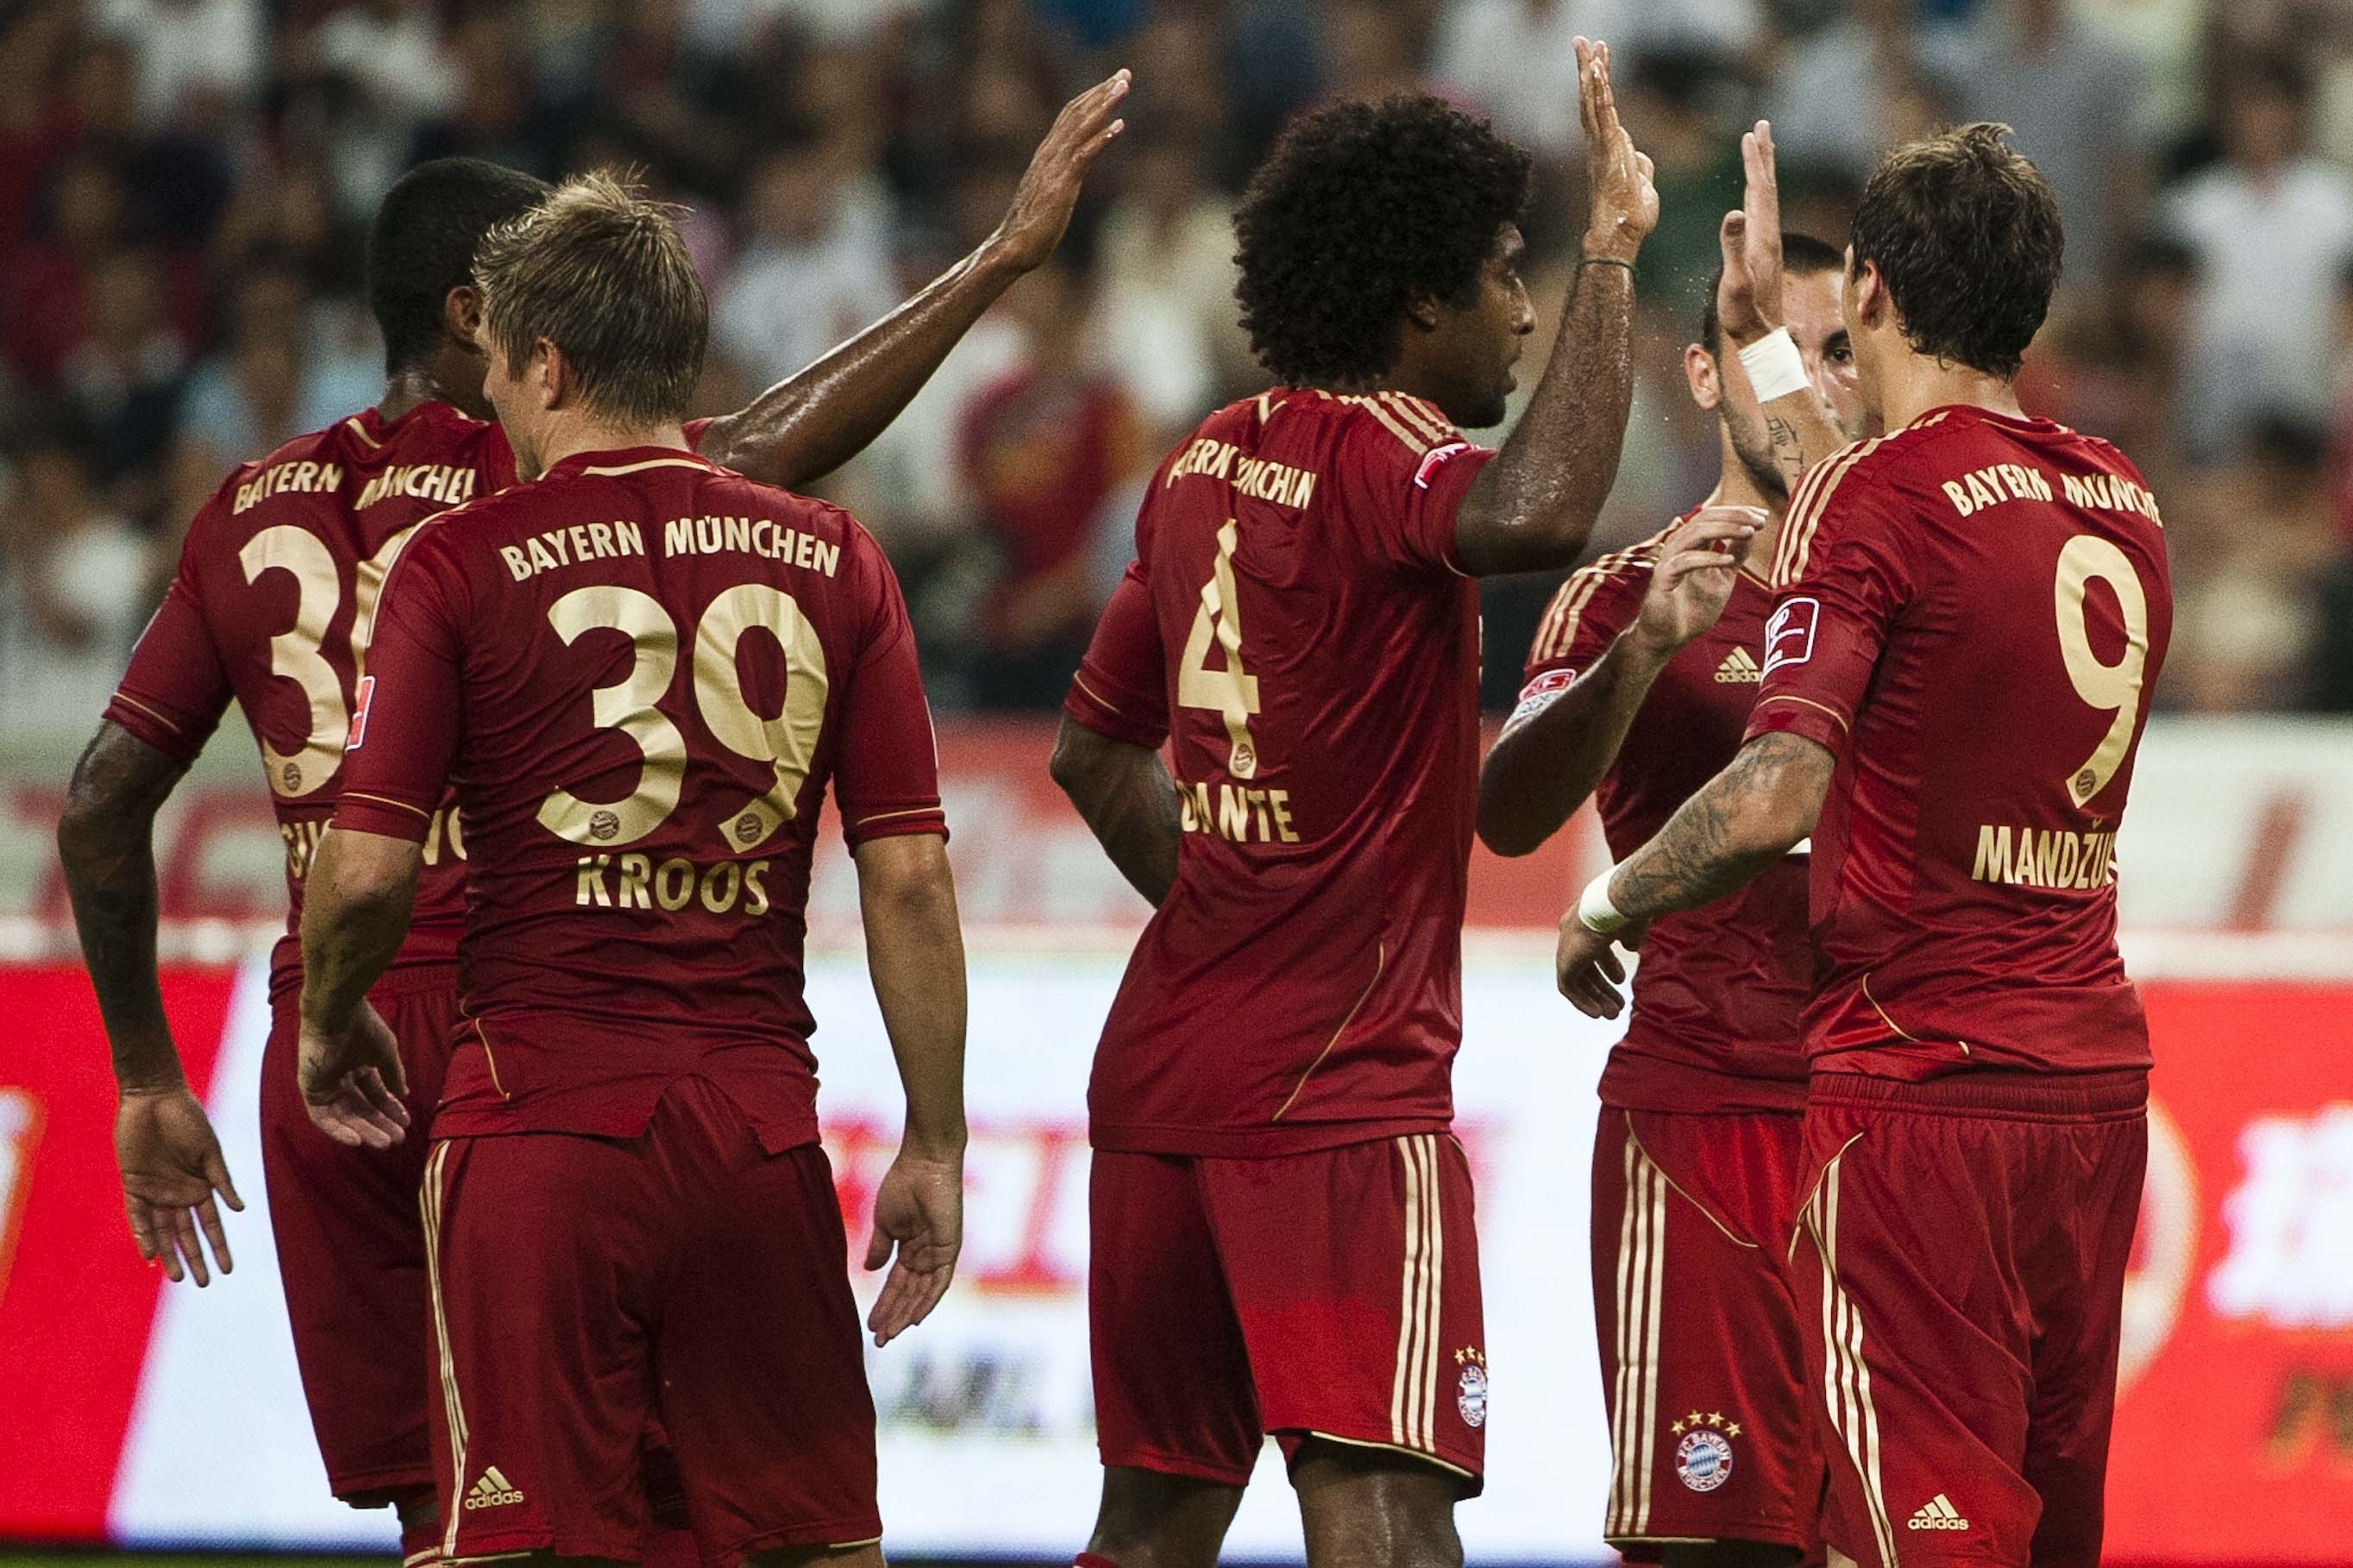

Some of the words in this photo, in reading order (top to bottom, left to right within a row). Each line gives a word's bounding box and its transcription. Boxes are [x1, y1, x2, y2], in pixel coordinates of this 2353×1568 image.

[232, 461, 343, 516] BAYERN
[1942, 463, 2054, 517] BAYERN
[500, 521, 645, 582] BAYERN
[664, 515, 840, 578] MÜNCHEN
[1177, 518, 1261, 780] 4
[1714, 669, 1765, 683] adida
[2055, 535, 2149, 808] 9
[536, 583, 829, 854] 39
[575, 854, 769, 916] KROOS
[465, 1490, 524, 1510] adidas
[1907, 1517, 1969, 1531] adidas
